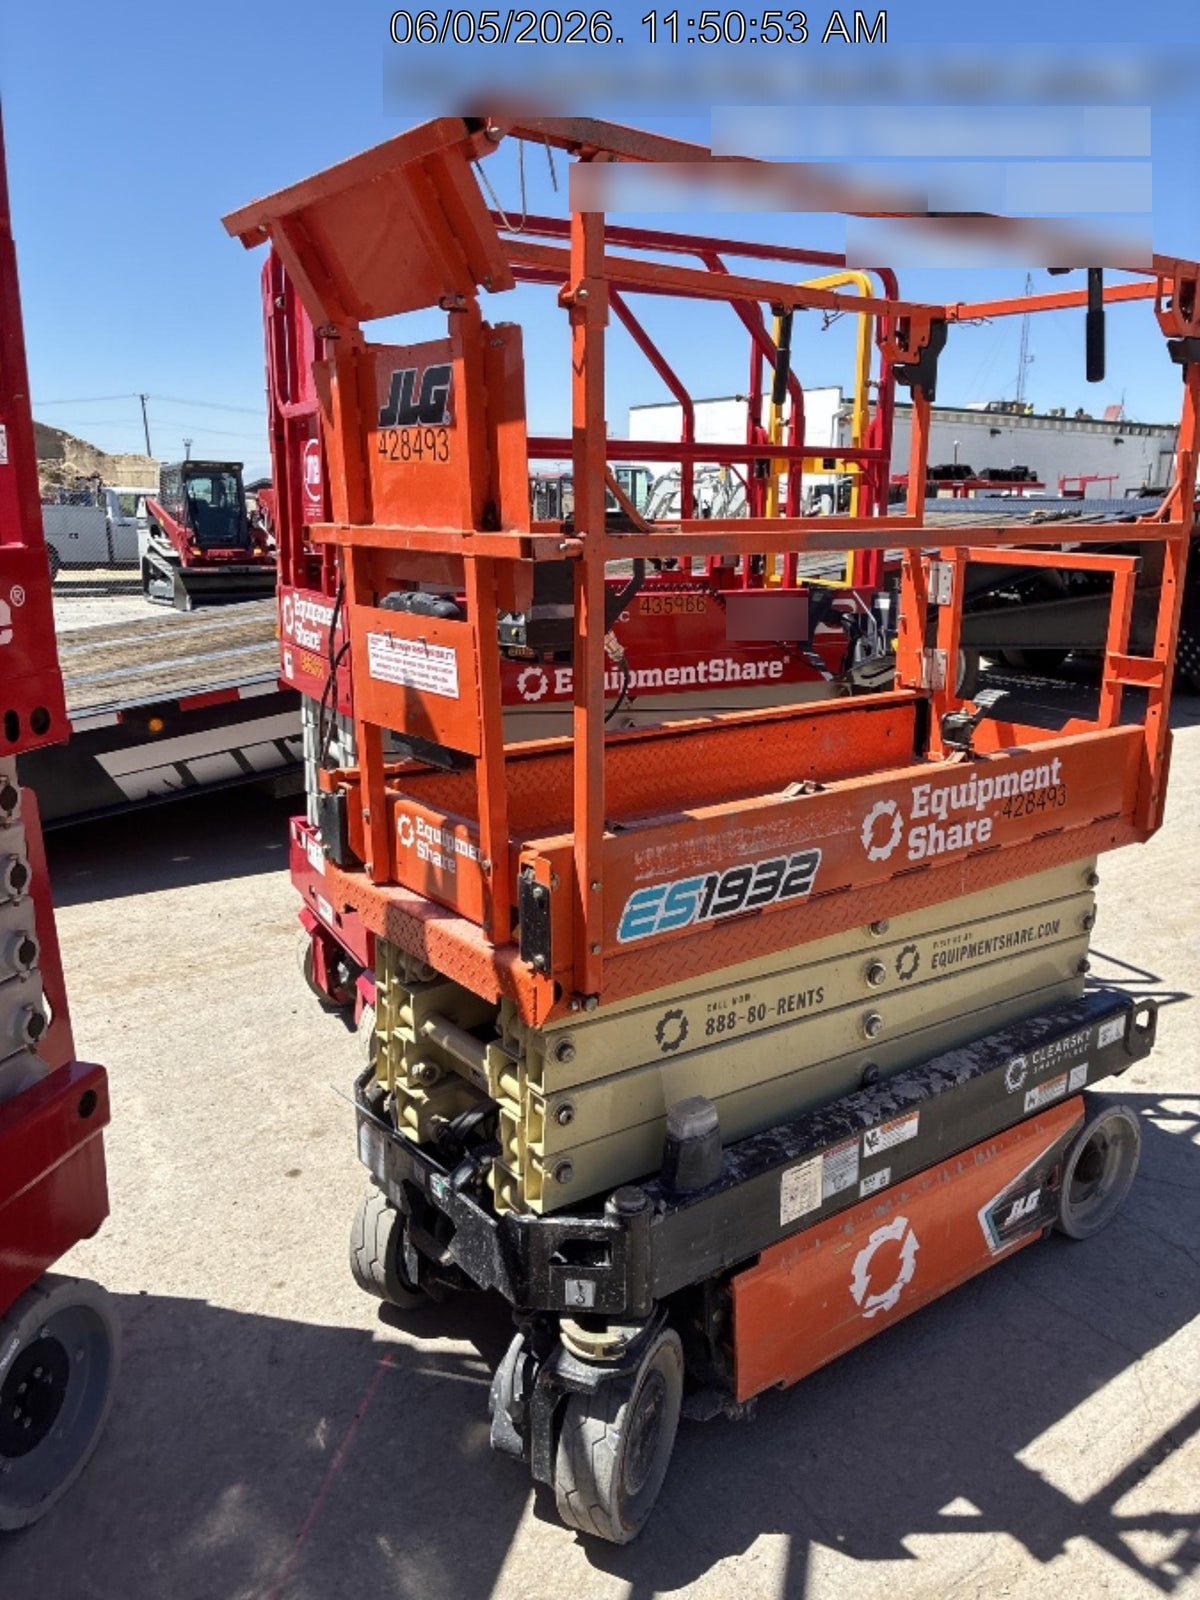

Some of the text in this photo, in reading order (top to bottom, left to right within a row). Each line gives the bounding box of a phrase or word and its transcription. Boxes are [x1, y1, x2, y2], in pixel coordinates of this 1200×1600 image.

[378, 363, 453, 429] JLG
[378, 428, 450, 461] 428493
[554, 659, 783, 694] EipmentShare
[910, 757, 1062, 821] Equipment
[1002, 784, 1066, 819] 428493
[416, 839, 455, 873] Share
[908, 817, 992, 861] Share
[617, 848, 822, 943] ES1932
[931, 919, 1061, 969] EQUIPMENTSHARE.COM
[705, 986, 824, 1036] 888-80-RENTS
[1032, 1026, 1093, 1064] CLEARSKY
[1004, 1188, 1041, 1226] JLG
